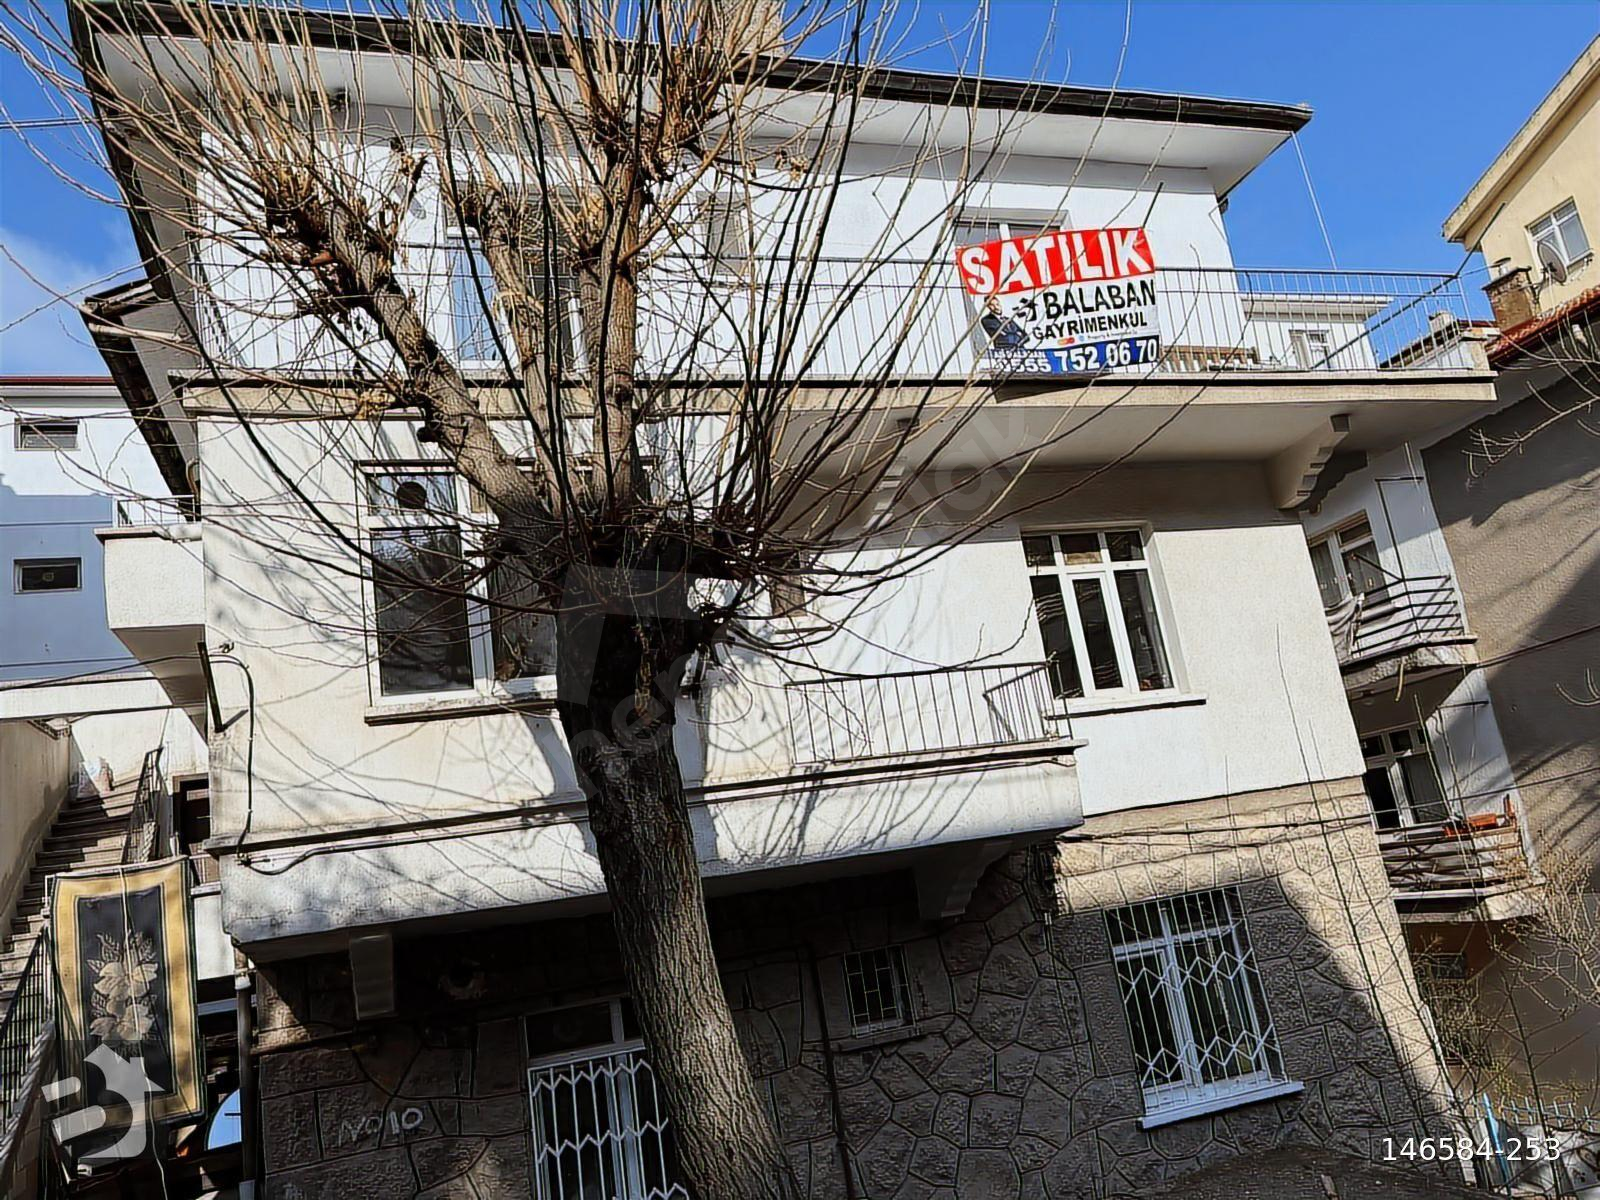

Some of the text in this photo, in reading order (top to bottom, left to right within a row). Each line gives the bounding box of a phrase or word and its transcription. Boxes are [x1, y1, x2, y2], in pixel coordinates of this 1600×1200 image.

[961, 230, 1152, 294] SATILIK
[1043, 279, 1156, 320] BALABAN
[1032, 311, 1148, 341] GAYRİMENKUL
[1054, 345, 1100, 372] 752
[1108, 342, 1131, 366] 06
[1137, 338, 1157, 362] 70
